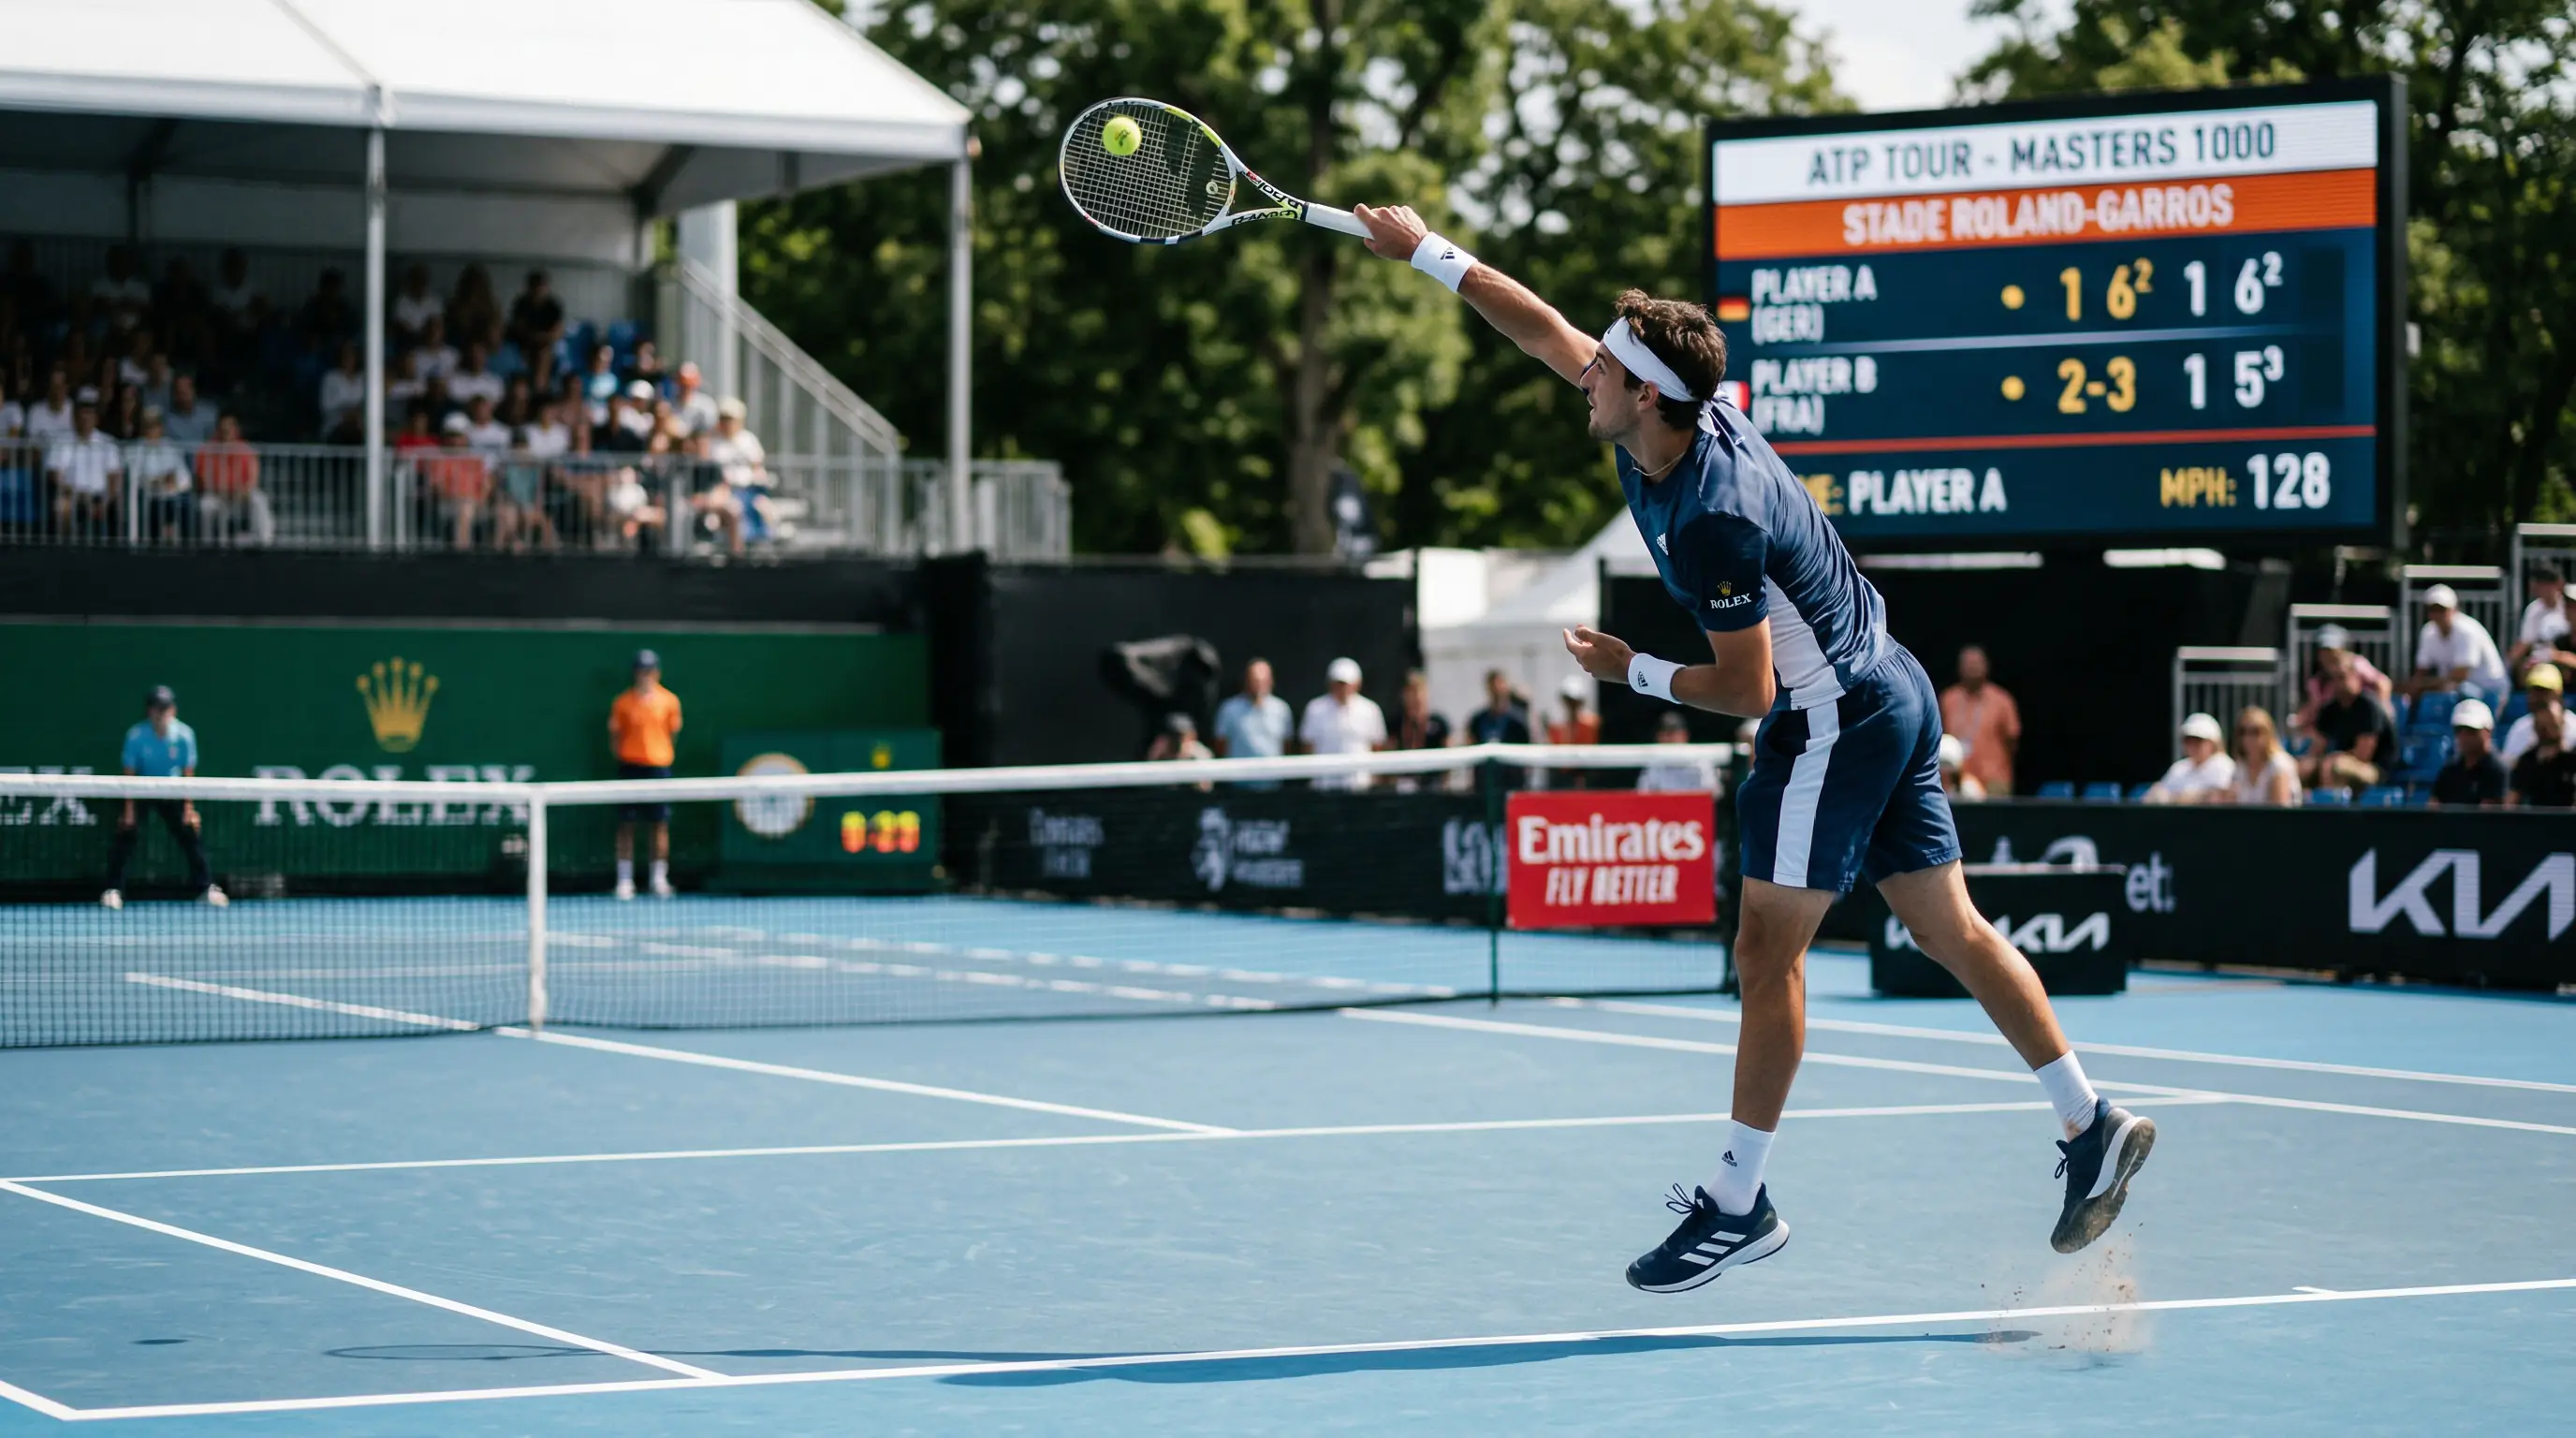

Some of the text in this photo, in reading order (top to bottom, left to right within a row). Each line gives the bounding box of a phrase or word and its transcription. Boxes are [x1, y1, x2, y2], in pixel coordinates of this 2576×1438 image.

[1808, 144, 1869, 185] ATP
[1885, 140, 1972, 180] TOUR
[2011, 126, 2176, 172] MASTERS
[2192, 121, 2276, 161] 1000
[1842, 183, 2234, 245] STADE ROLAND-GARROS
[1751, 264, 1878, 303] PLAYER A
[2059, 267, 2082, 321] 1
[2184, 260, 2206, 316] 1
[1751, 303, 1824, 345] (GER)
[1751, 355, 1878, 395] PLAYER B
[2057, 356, 2137, 414] 2-3
[2184, 352, 2206, 410] 1
[1849, 468, 1974, 514] PLAYER
[1980, 467, 2008, 512] A
[2160, 451, 2331, 509] MPH: 128
[1710, 593, 1752, 609] ROLEX
[253, 764, 535, 827] ROLEX
[1517, 813, 1705, 864] Emirates
[1544, 867, 1589, 905] FLY
[1590, 865, 1678, 904] BETTER
